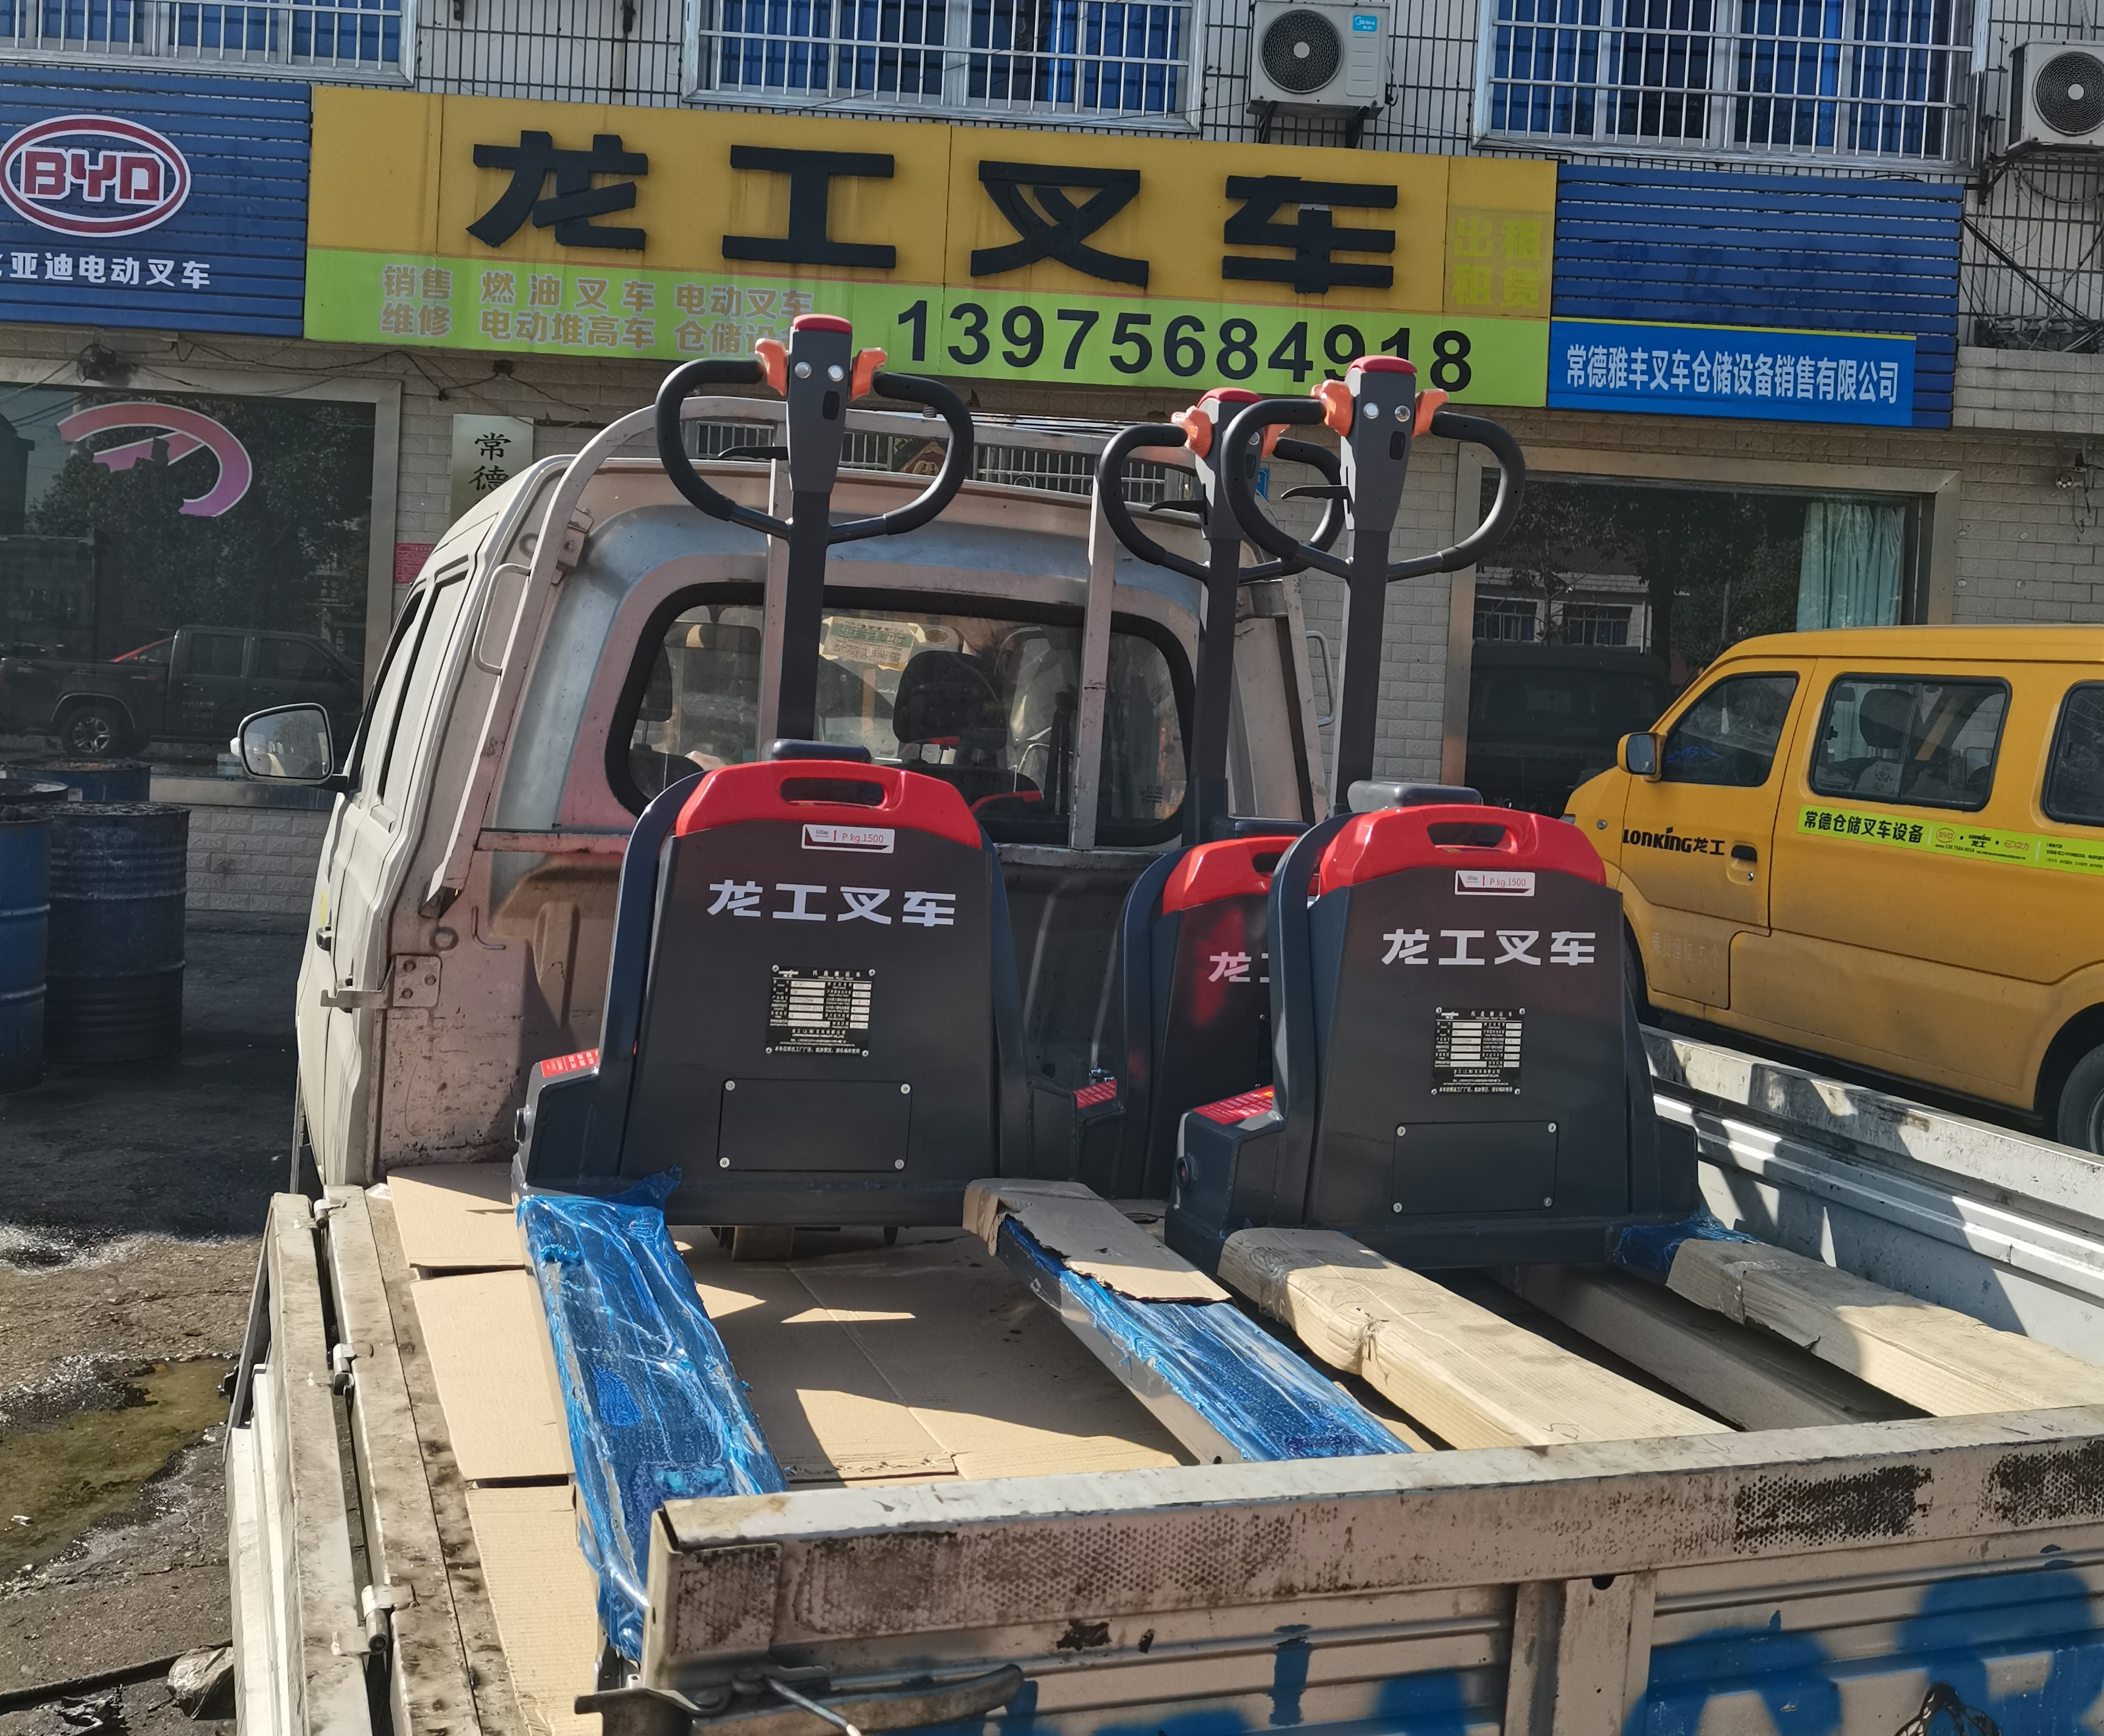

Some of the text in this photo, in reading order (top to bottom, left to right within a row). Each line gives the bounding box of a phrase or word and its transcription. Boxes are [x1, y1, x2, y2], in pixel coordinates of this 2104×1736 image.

[21, 147, 164, 203] BYD
[466, 130, 1398, 295] 龙工叉车
[1454, 216, 1542, 261] 出租
[0, 251, 211, 289] 亚迪电动叉车
[382, 265, 812, 320] 销售 燃油叉车 电动叉车
[1451, 263, 1542, 310] 租赁
[380, 303, 790, 354] 维修 电动堆高车 仓储设
[897, 300, 1472, 393] 13975684918
[1566, 343, 1899, 404] 常德雅丰叉车仓储设备销售有限公司
[468, 432, 512, 496] 常德
[1692, 837, 1725, 856] 龙工
[1804, 810, 1924, 843] 常德仓储叉车设备
[707, 879, 956, 927] 龙工叉车
[1208, 951, 1270, 982] 龙
[1381, 929, 1596, 966] 龙工叉车
